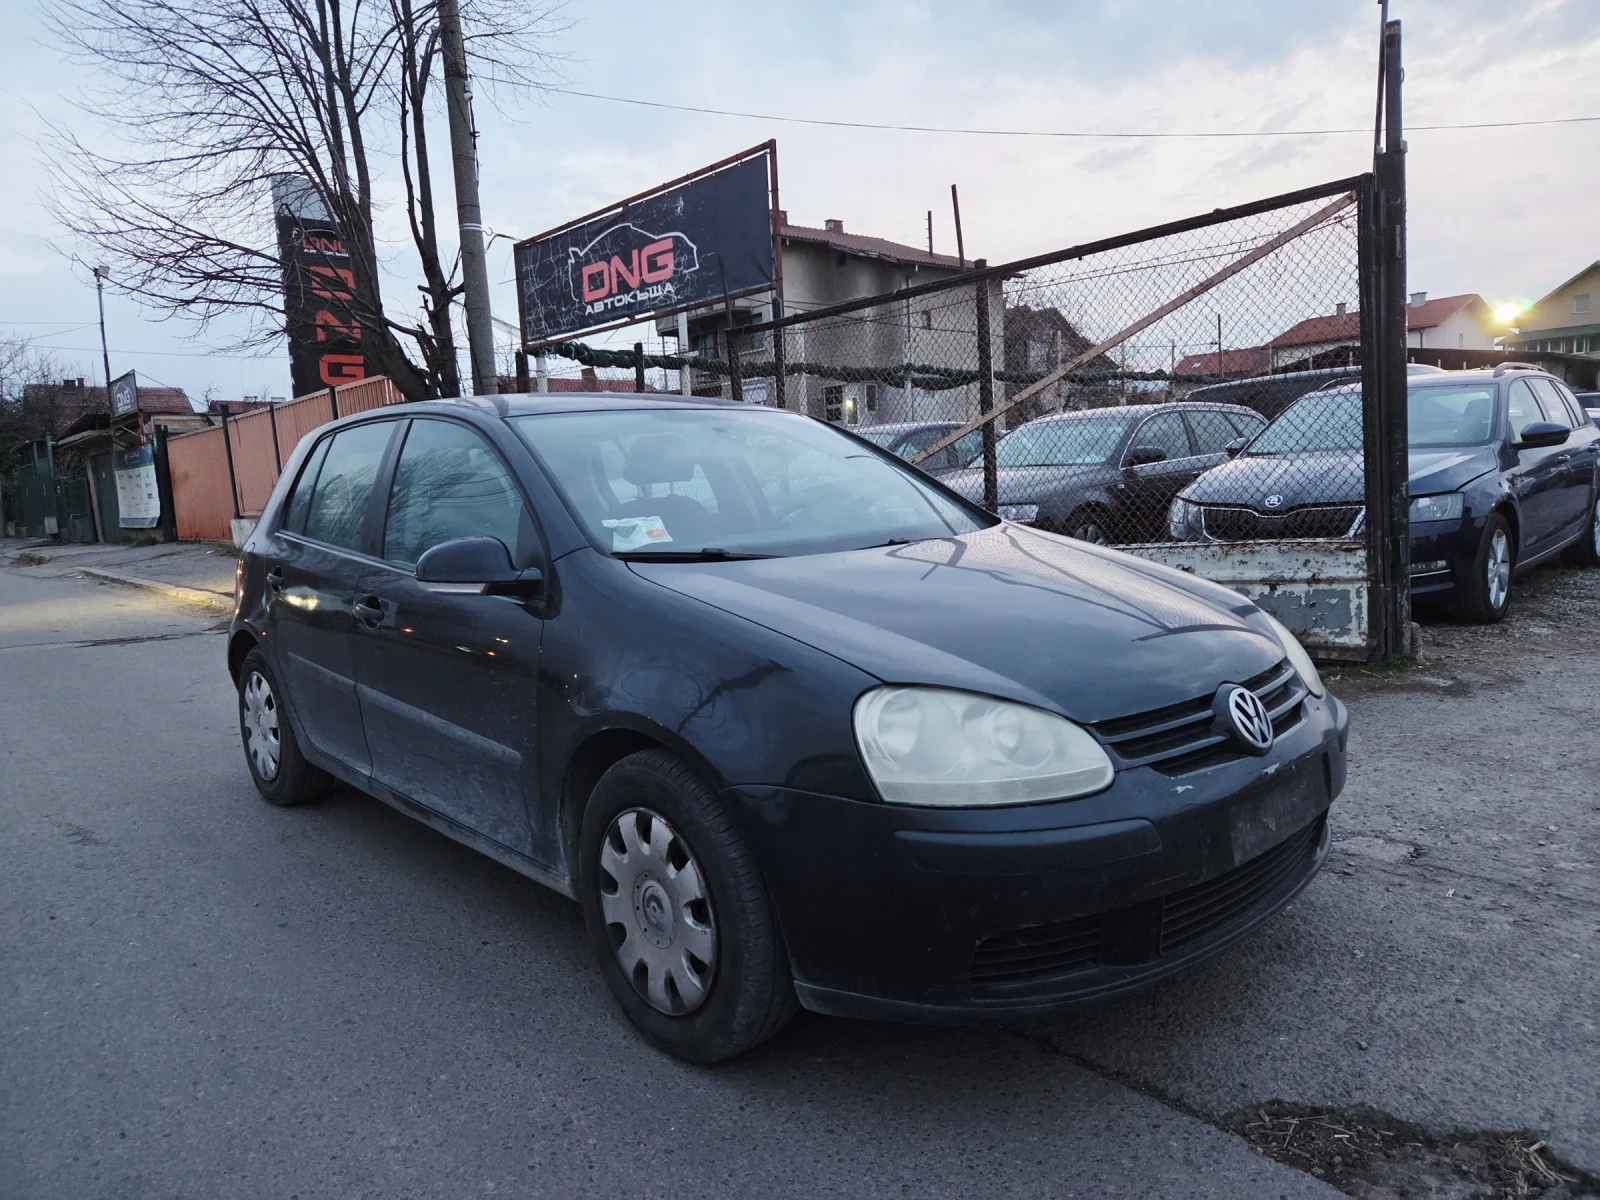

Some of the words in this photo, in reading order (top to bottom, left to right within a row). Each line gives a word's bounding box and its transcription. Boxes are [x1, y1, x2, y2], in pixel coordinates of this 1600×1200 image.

[582, 237, 675, 303] DNG
[116, 389, 131, 408] DNG
[1231, 689, 1272, 746] VW
